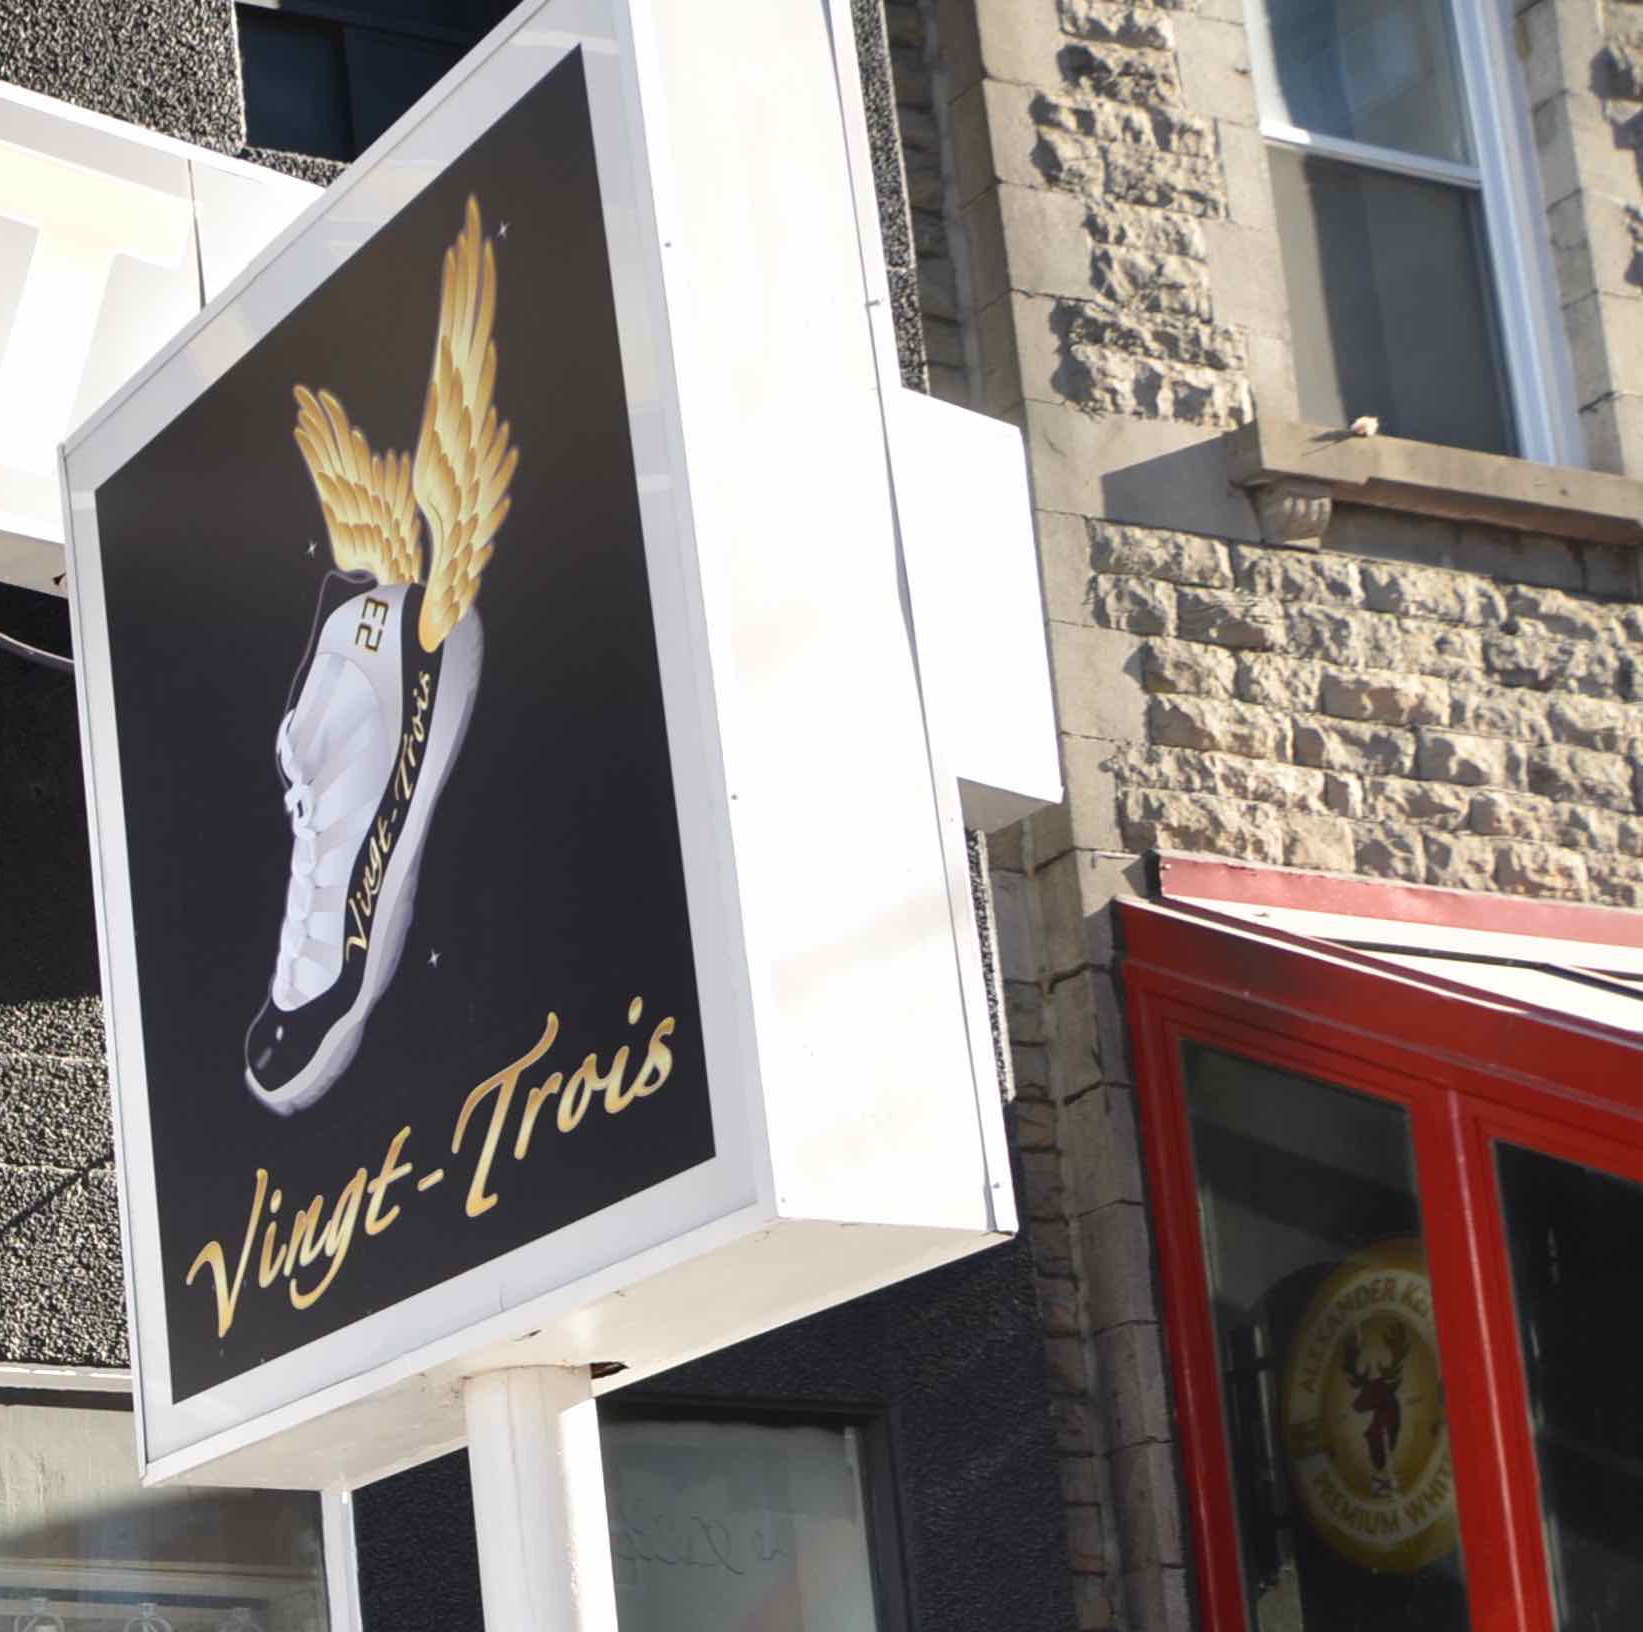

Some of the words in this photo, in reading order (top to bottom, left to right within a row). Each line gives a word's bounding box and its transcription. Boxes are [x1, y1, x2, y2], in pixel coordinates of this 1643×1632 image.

[354, 597, 389, 652] 23
[345, 671, 433, 962] Vingt-Trois
[186, 996, 676, 1338] Vingt-Trois
